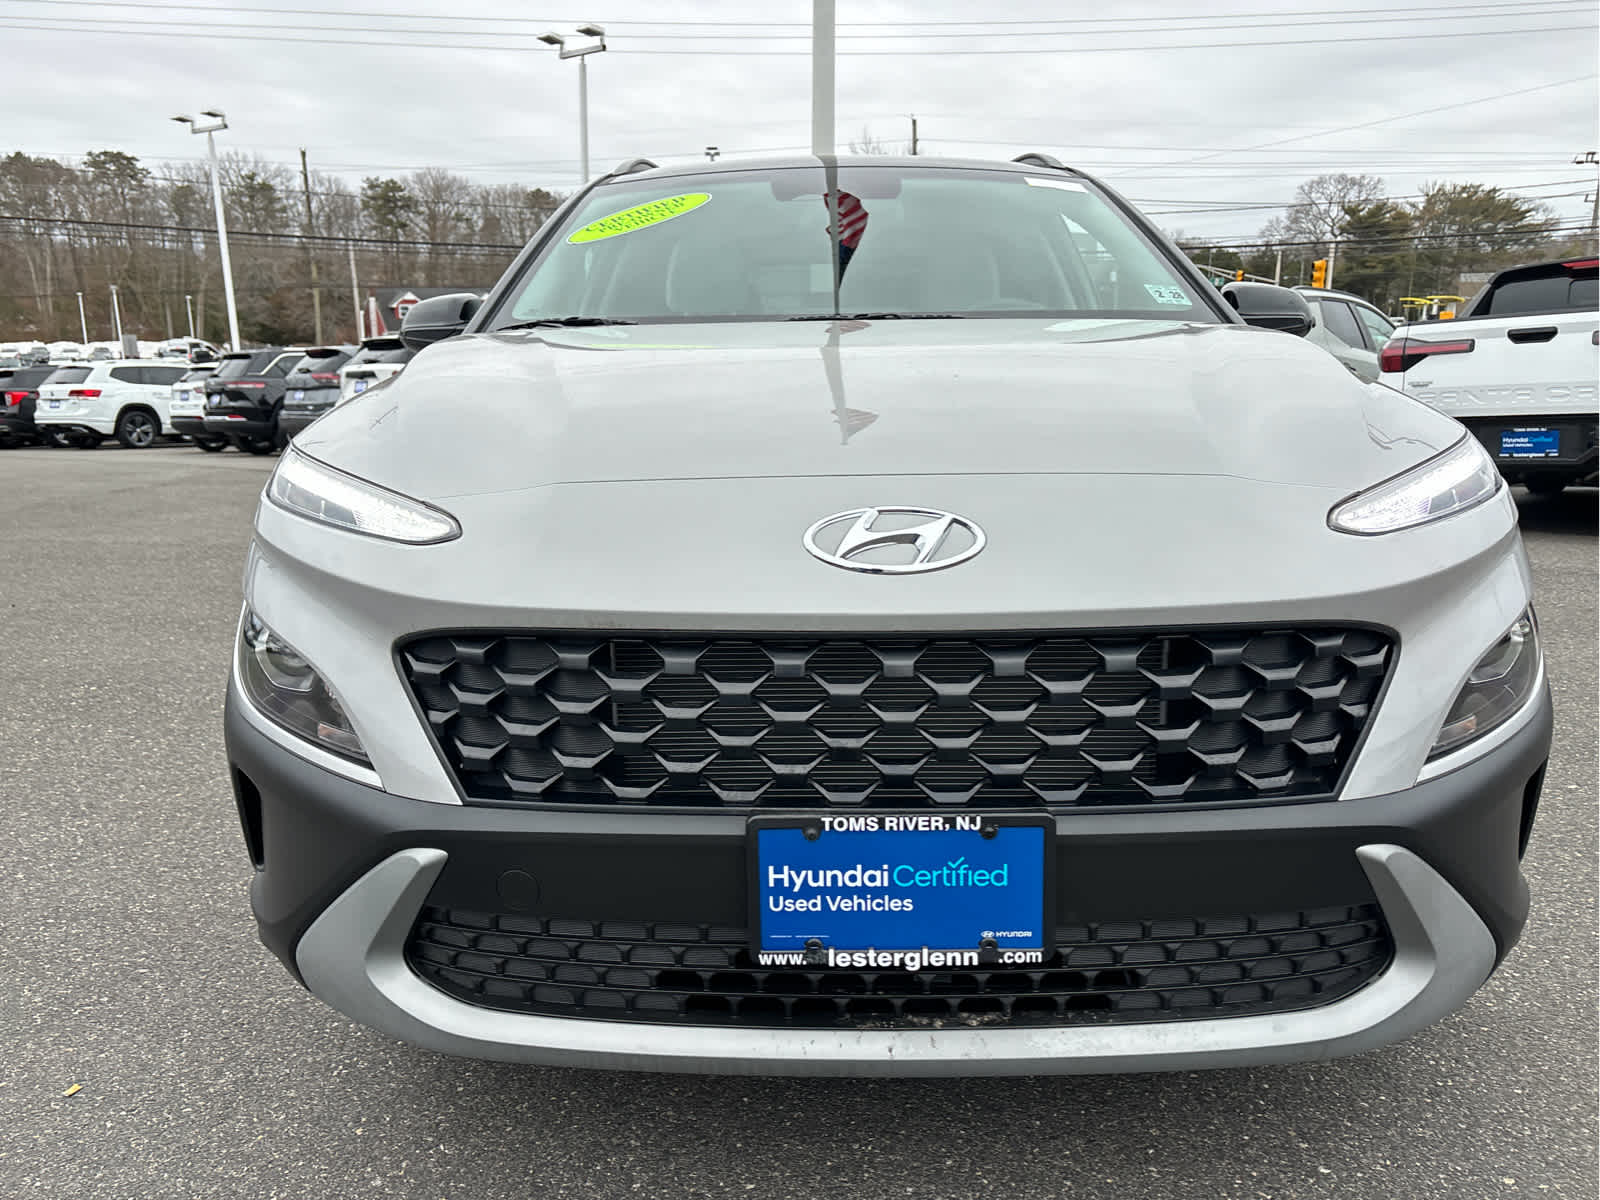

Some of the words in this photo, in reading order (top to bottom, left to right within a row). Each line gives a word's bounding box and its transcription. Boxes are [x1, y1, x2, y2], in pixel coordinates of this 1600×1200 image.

[585, 196, 686, 232] CERTIFIED
[821, 816, 879, 832] TOMS
[884, 816, 950, 832] RIVER,
[955, 815, 982, 831] NJ
[768, 865, 889, 892] Hyundai
[893, 857, 1009, 887] Certified
[769, 895, 822, 912] Used
[826, 894, 914, 912] Vehicles
[828, 948, 979, 971] lesterglenn
